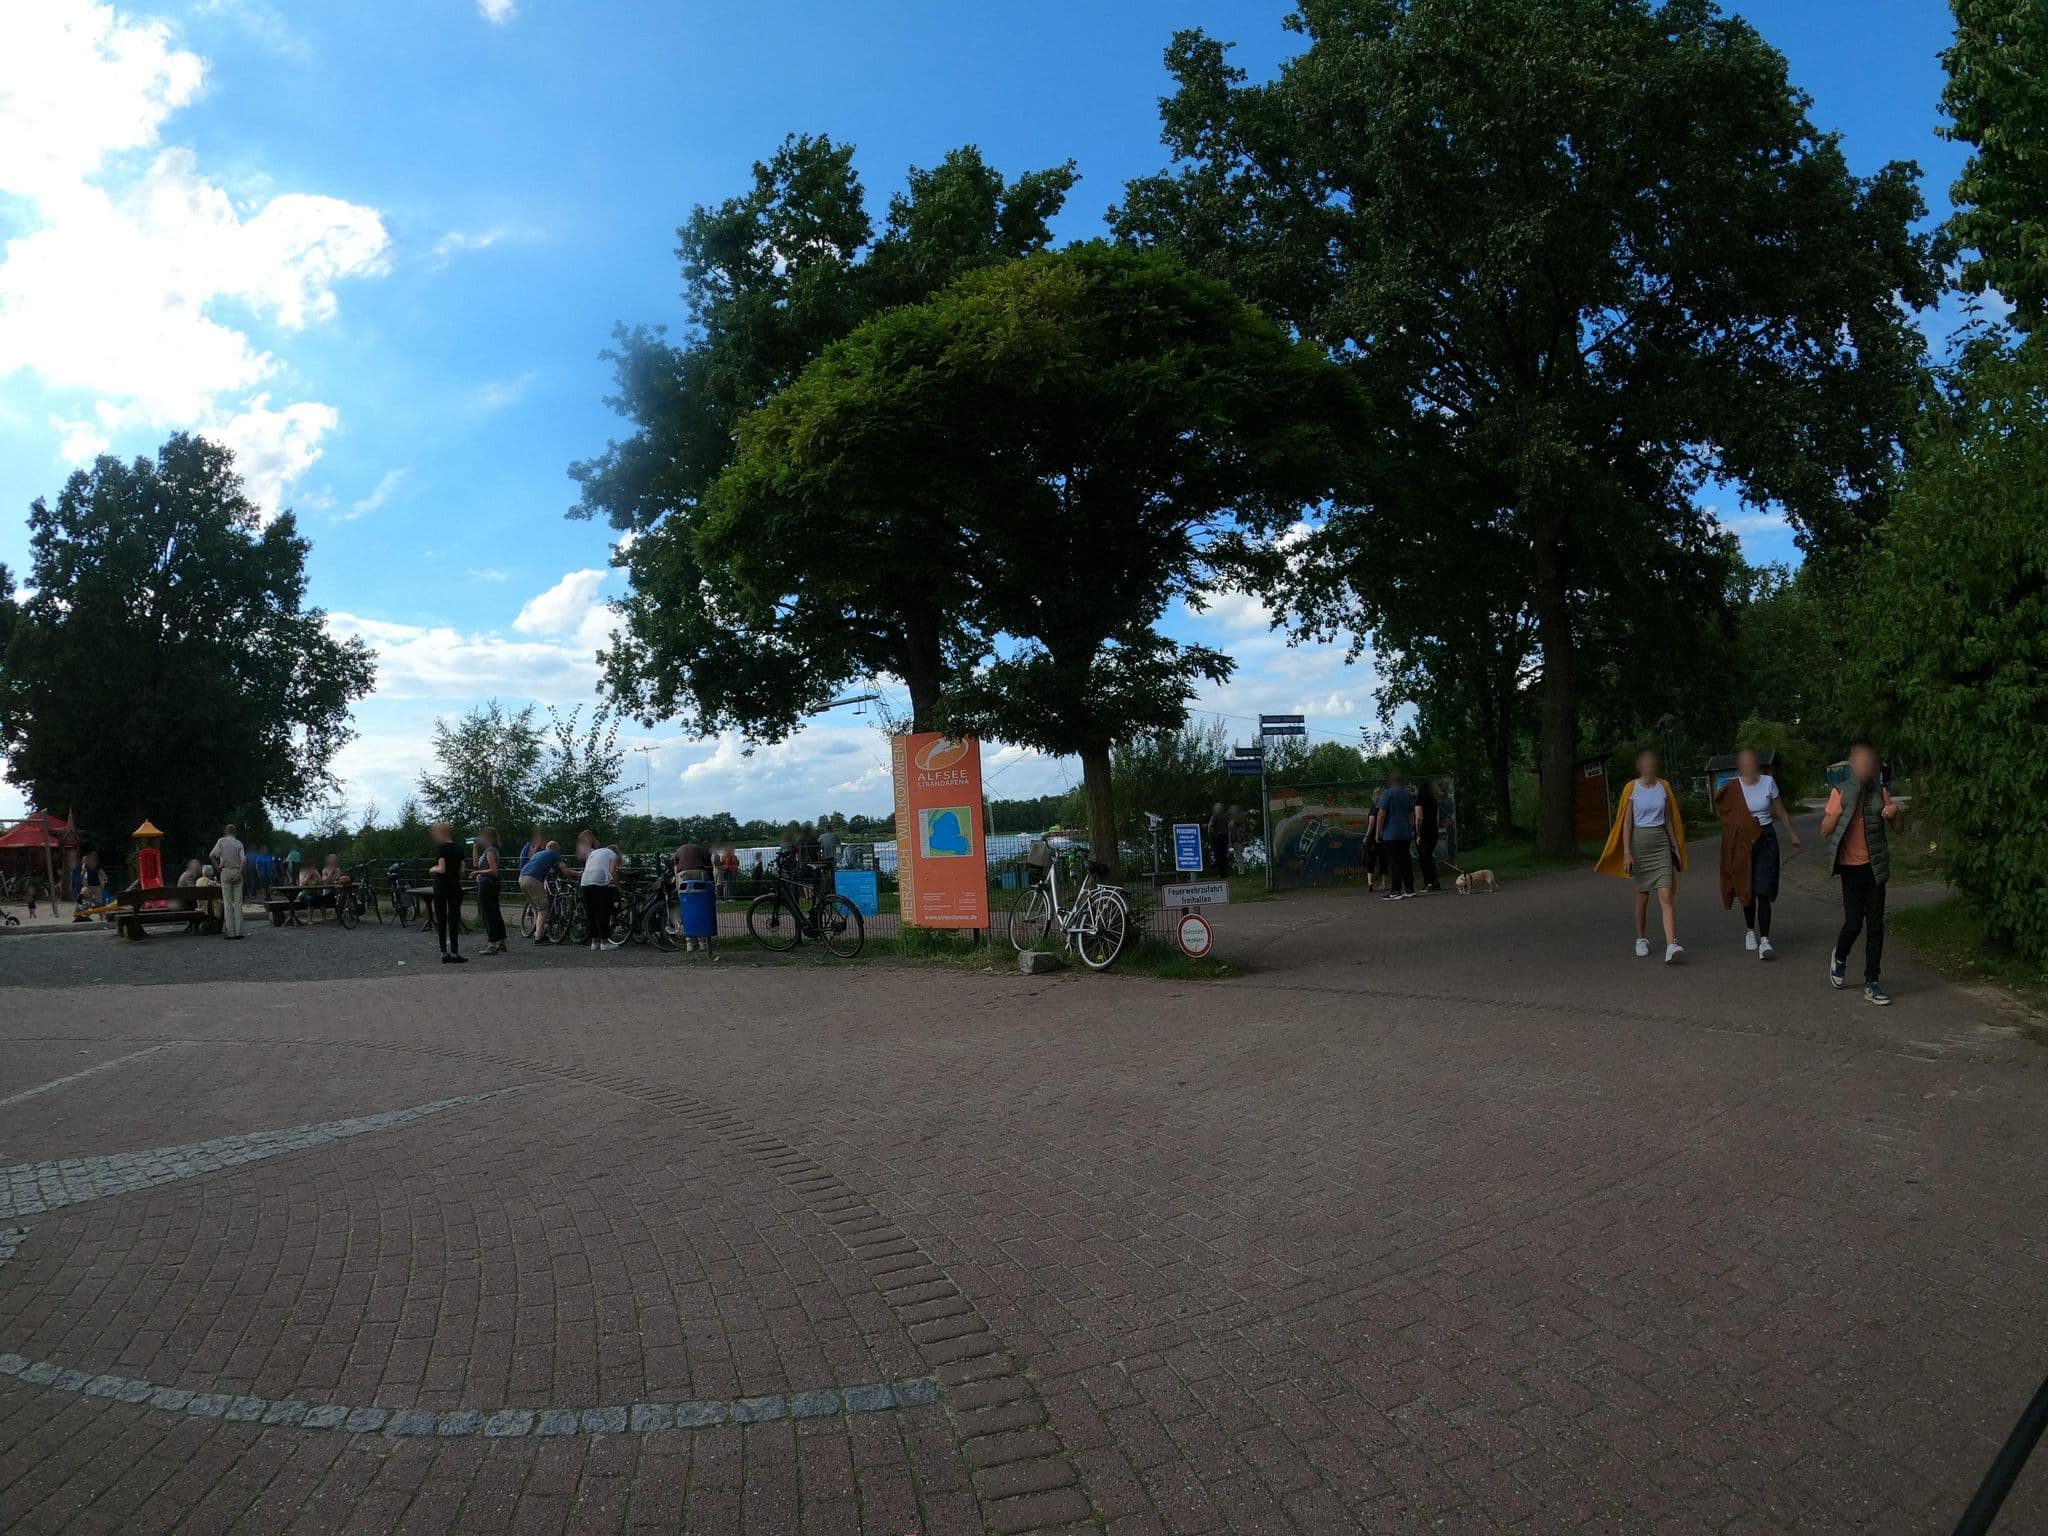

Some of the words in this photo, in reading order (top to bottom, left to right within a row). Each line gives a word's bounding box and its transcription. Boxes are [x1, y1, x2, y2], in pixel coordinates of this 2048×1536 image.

[917, 769, 968, 781] ALFSEE
[917, 778, 970, 788] STRANDARENA
[895, 743, 910, 840] WILLKOMMEN
[901, 850, 914, 920] HERZLICH
[1168, 885, 1223, 896] Feuerwehrzufahrt
[1181, 896, 1212, 905] freihalten
